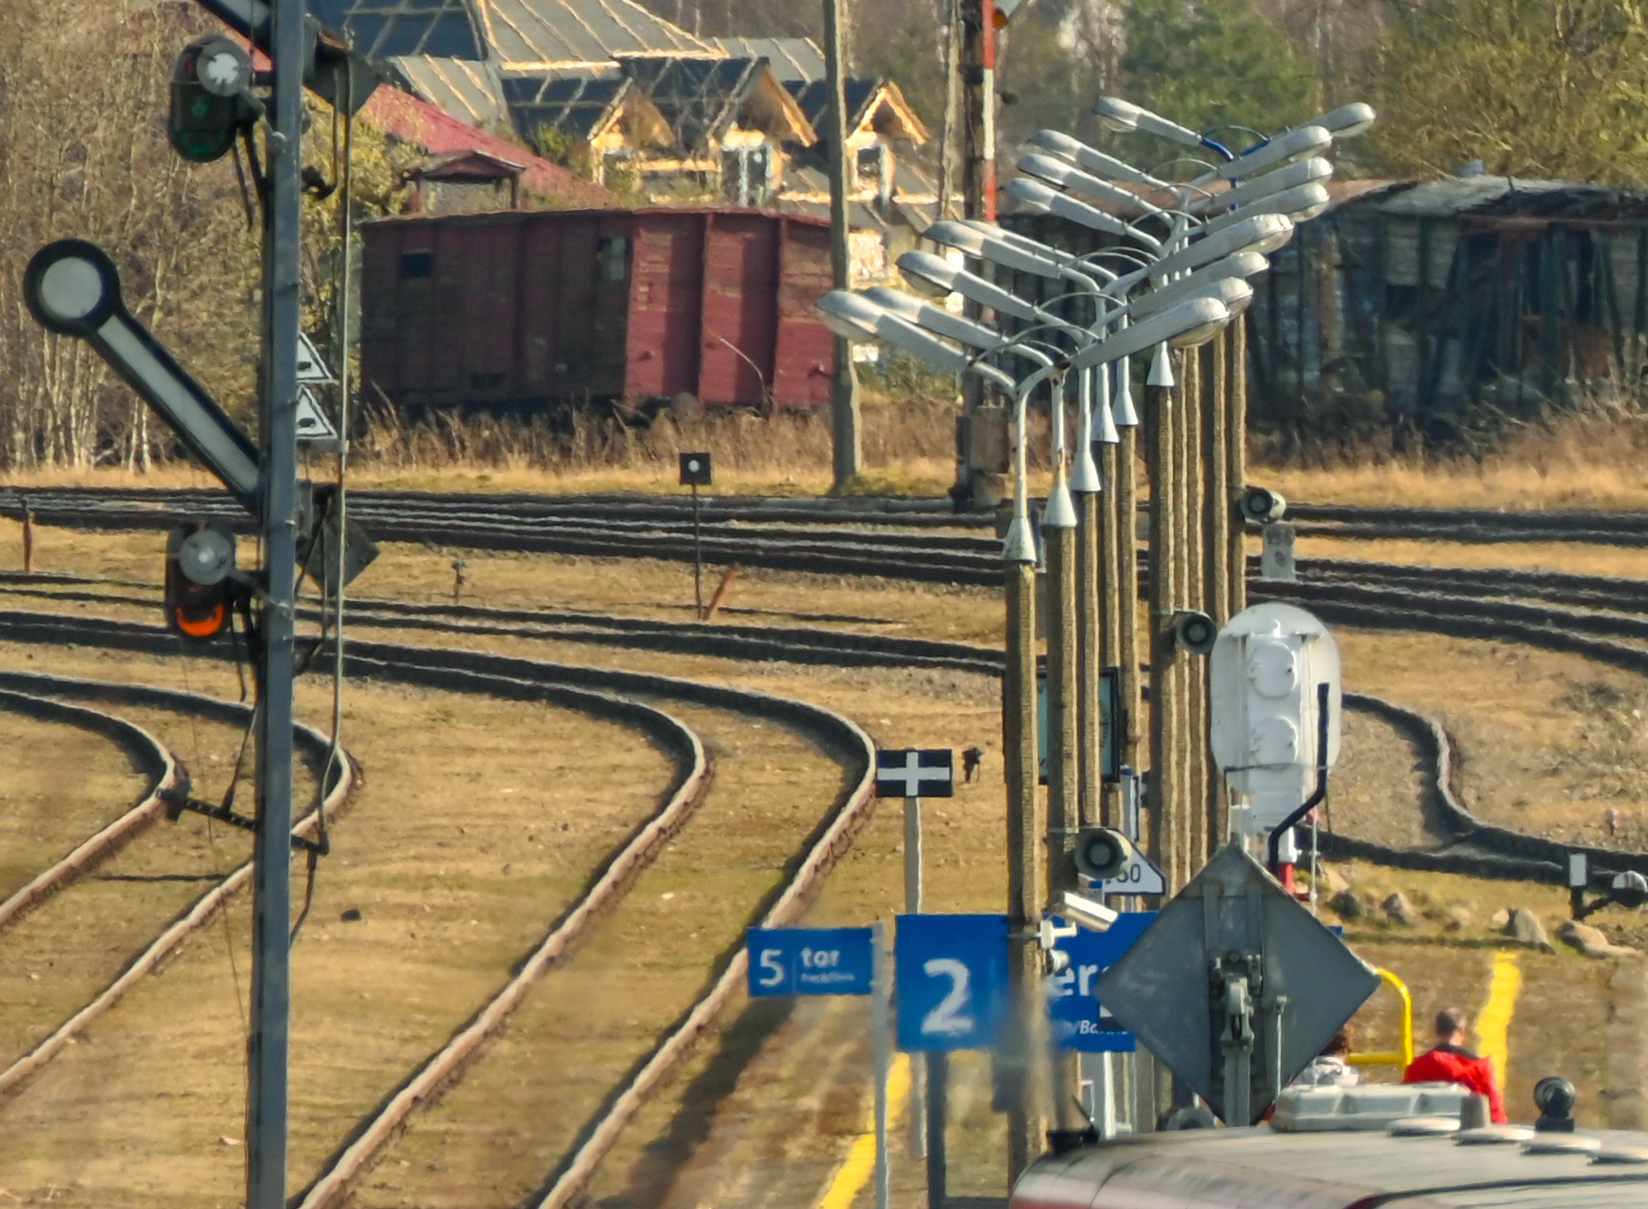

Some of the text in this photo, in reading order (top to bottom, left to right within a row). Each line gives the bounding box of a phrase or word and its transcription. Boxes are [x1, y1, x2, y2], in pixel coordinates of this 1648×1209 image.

[760, 949, 785, 986] 5
[801, 947, 839, 968] tor
[921, 958, 974, 1035] 2
